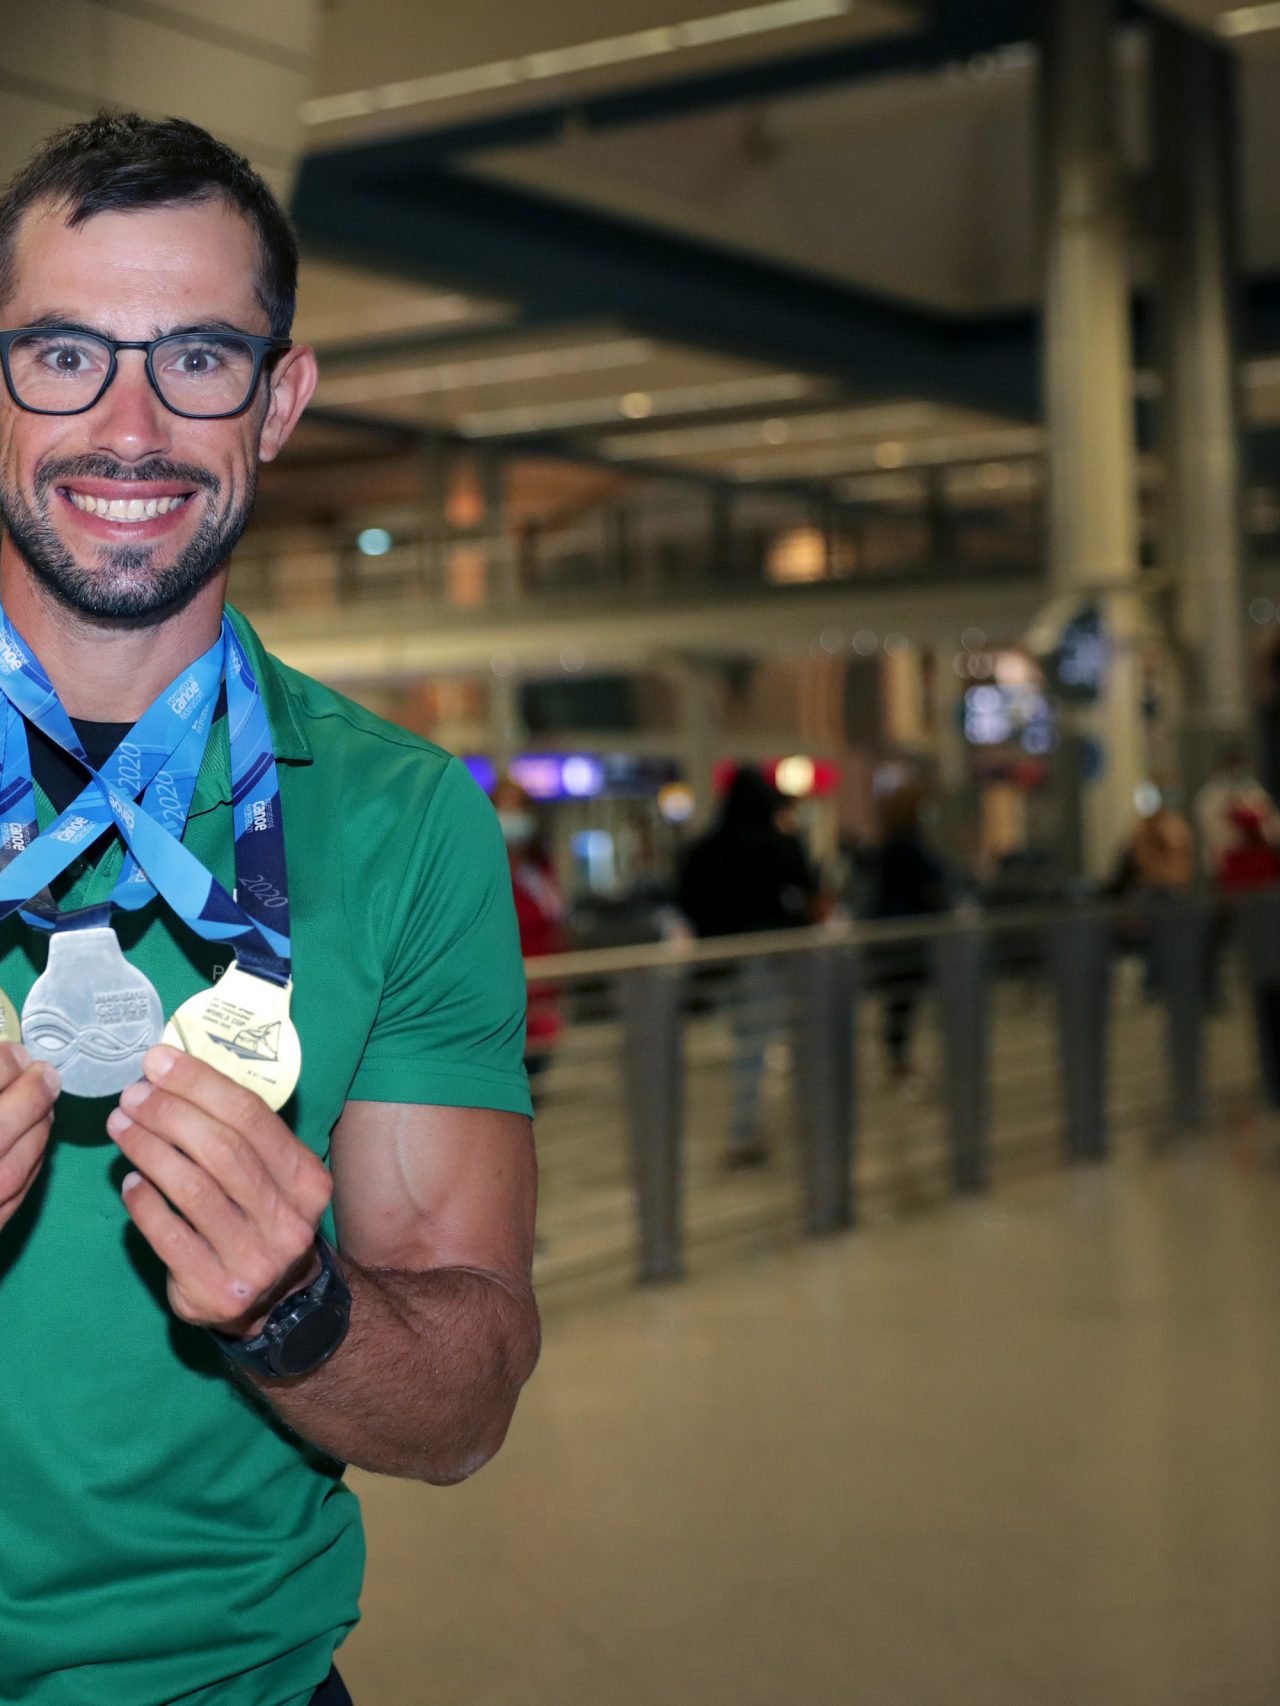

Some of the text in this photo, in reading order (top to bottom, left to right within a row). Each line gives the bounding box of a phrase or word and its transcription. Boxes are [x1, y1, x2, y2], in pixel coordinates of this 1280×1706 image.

[171, 680, 200, 714] canoe
[117, 742, 141, 791] 2020
[156, 771, 187, 822] 2020
[57, 816, 89, 842] canoe
[252, 800, 268, 832] canoe
[9, 822, 25, 851] canoe
[238, 874, 289, 908] 2020
